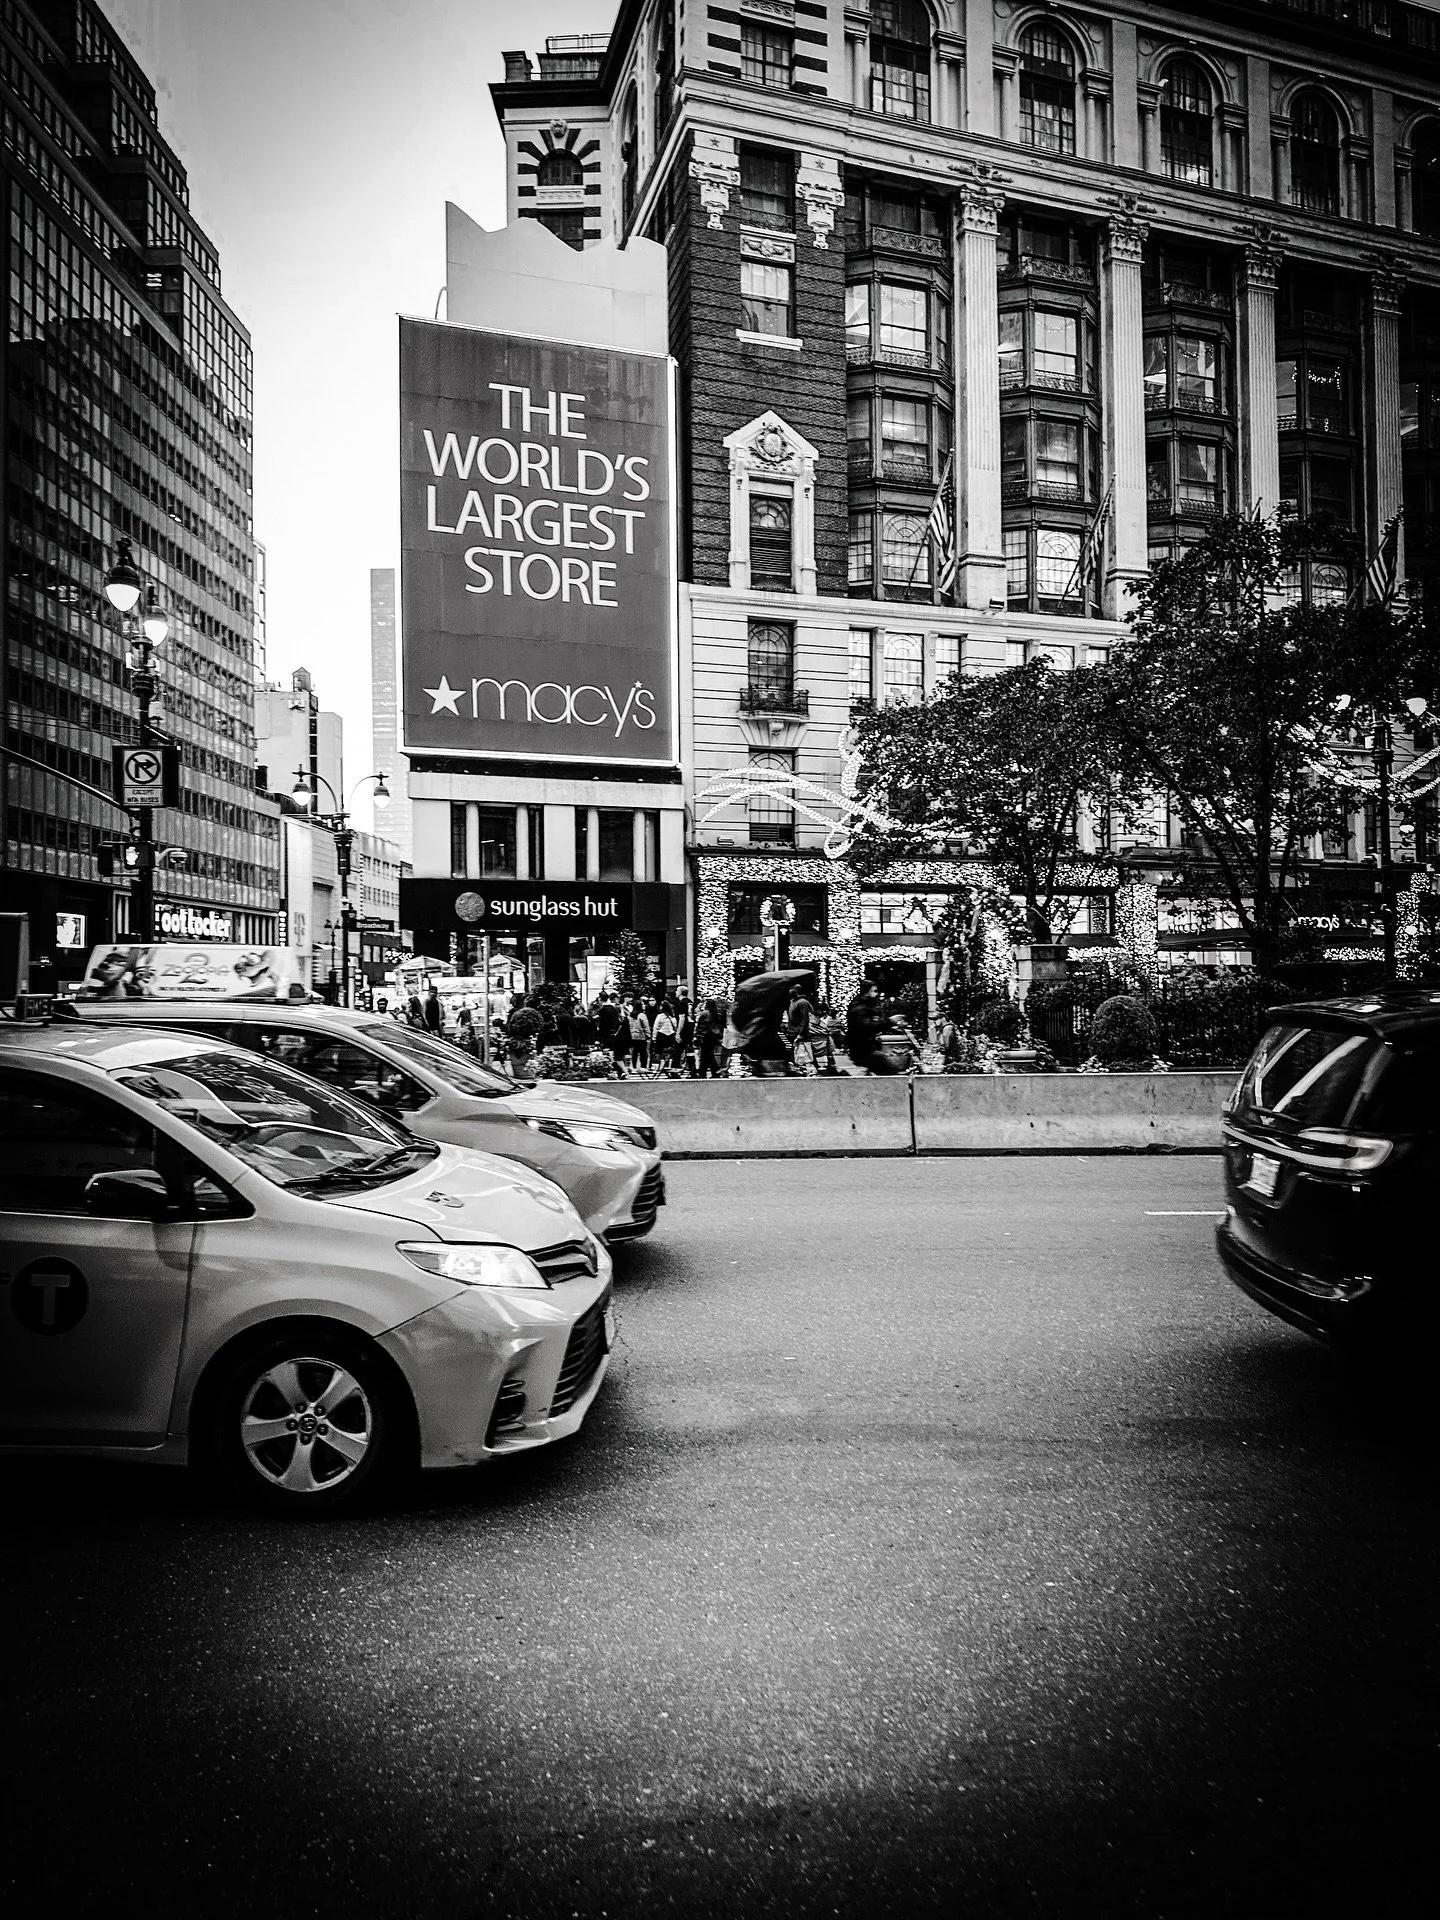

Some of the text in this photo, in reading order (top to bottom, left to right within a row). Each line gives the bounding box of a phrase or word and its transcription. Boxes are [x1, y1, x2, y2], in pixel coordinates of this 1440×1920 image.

[488, 382, 588, 440] THE
[423, 429, 651, 502] WORLD'S
[427, 485, 646, 555] LARGEST
[464, 546, 619, 607] STORE
[490, 895, 619, 922] sunglass hut
[30, 1273, 71, 1326] T
